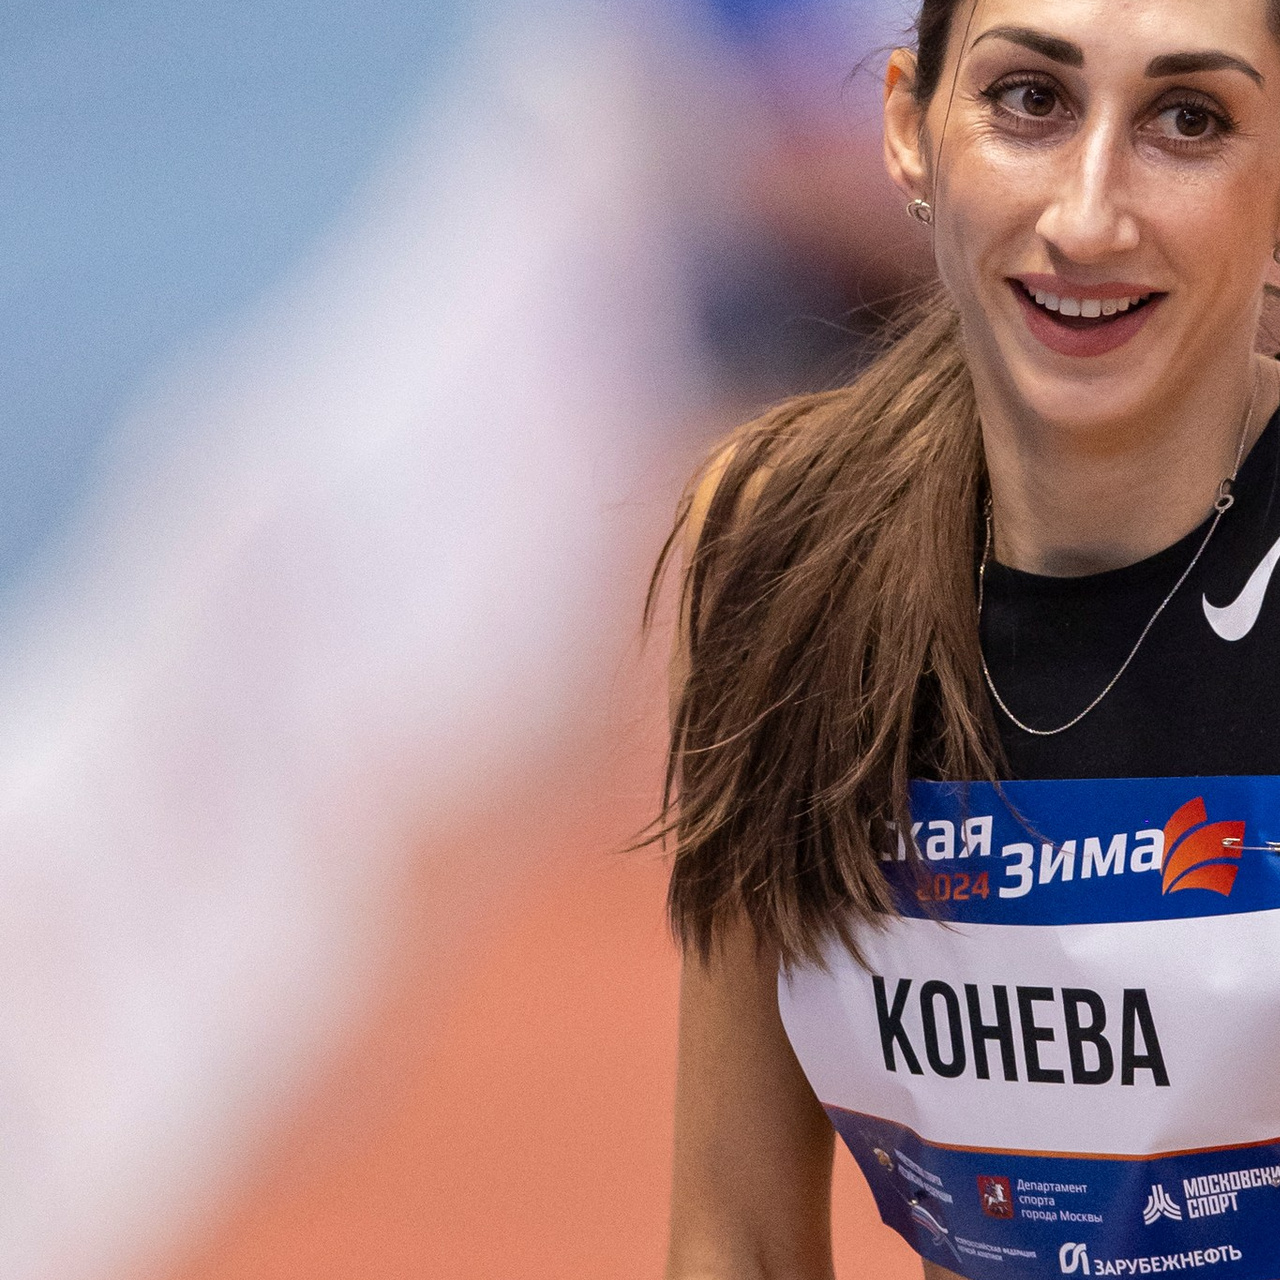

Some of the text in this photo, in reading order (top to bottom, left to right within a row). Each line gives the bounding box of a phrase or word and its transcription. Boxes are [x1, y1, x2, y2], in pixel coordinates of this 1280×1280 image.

[880, 814, 993, 862] кая
[871, 975, 1171, 1088] КОНЕВА
[1017, 1178, 1088, 1194] Департамент
[1018, 1194, 1056, 1208] спорта
[1186, 1191, 1239, 1219] СПОРТ
[1021, 1208, 1103, 1224] города Москвы
[1094, 1244, 1243, 1276] ЗАРУБЕЖНЕФТЬ
